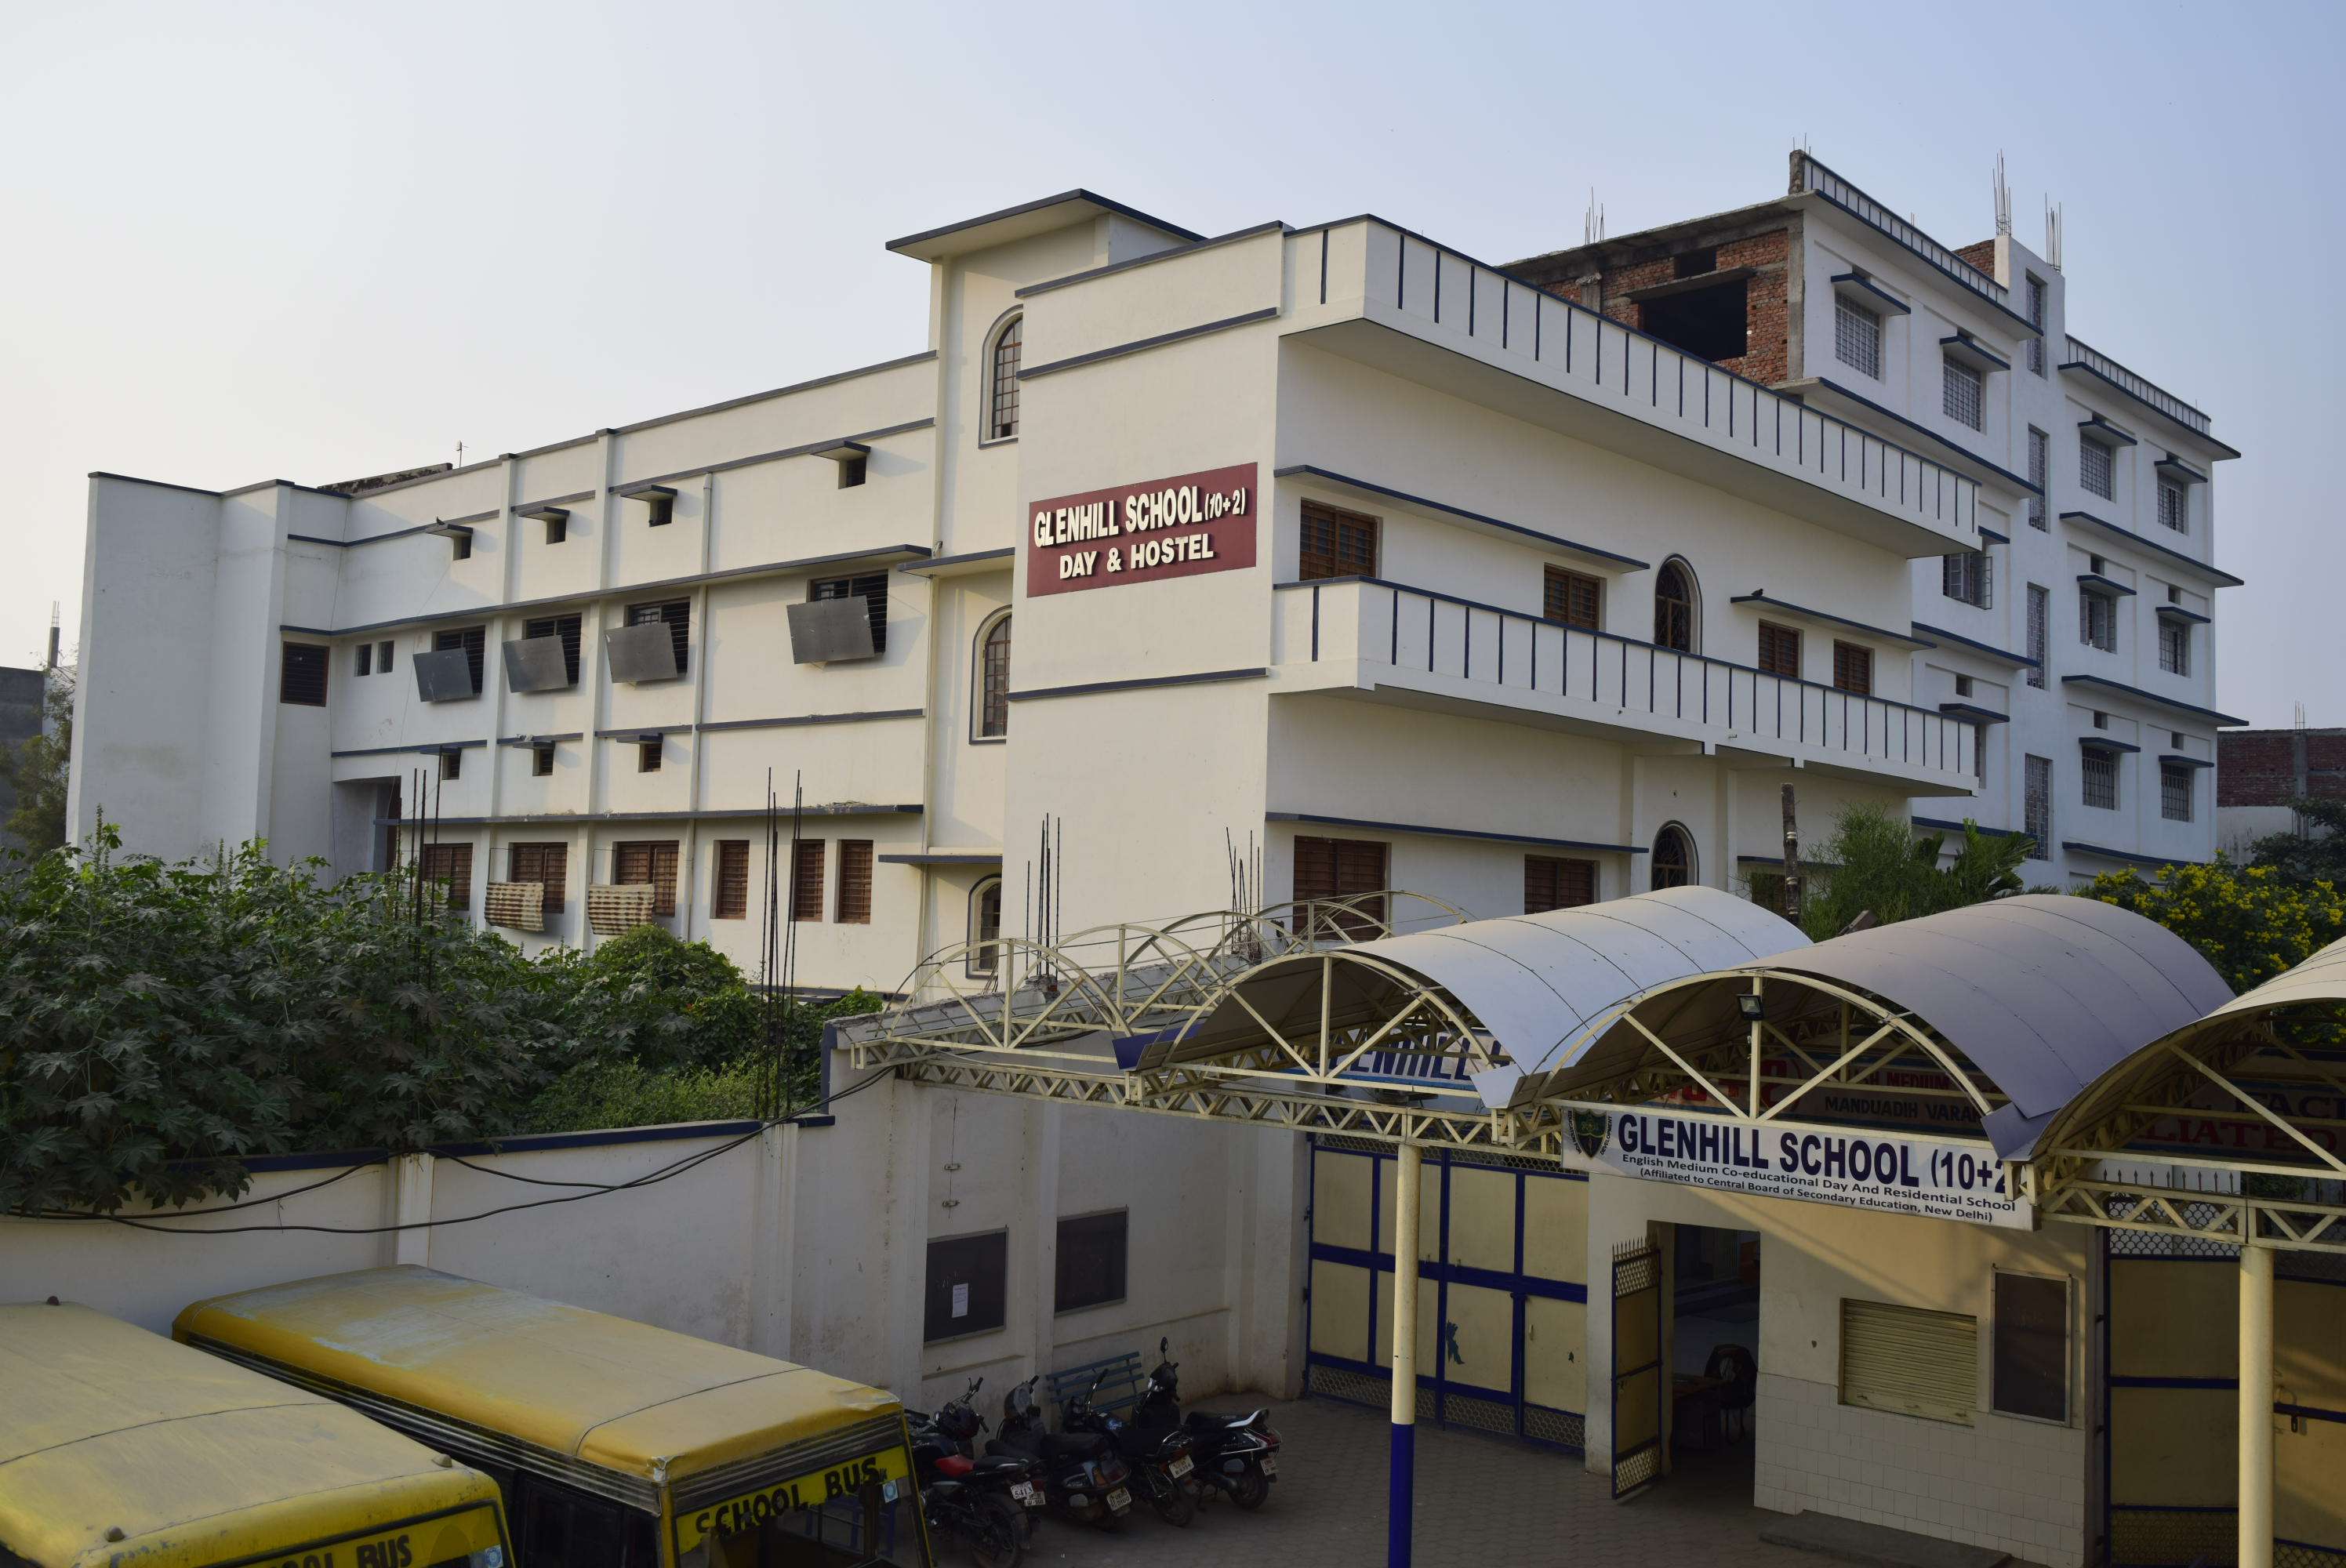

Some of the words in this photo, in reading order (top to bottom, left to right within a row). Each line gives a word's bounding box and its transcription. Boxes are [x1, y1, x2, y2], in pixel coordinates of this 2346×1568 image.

[1034, 500, 1119, 547] GLENHILL
[1125, 485, 1202, 533] SCHOOL
[1204, 487, 1246, 521] (10+2)
[1059, 550, 1097, 579] DAY
[1106, 547, 1122, 572] &
[1131, 533, 1214, 569] HOSTEL
[1825, 1096, 1918, 1119] MANDUADIH
[1618, 1114, 1769, 1169] GLENHILL
[1779, 1132, 1919, 1188] SCHOOL
[1931, 1149, 2005, 1194] (10+2
[1622, 1154, 1663, 1167] English
[1667, 1160, 1718, 1174] Medium
[1723, 1167, 1818, 1187] Co-educational
[1823, 1179, 1848, 1192] Day
[1852, 1183, 1879, 1194] And
[1884, 1187, 1962, 1205] Residential
[1966, 1196, 2015, 1211] School
[1640, 1167, 1690, 1182] (Affiliated
[1694, 1176, 1705, 1185] to
[1707, 1177, 1745, 1189] Central
[1749, 1182, 1780, 1194] Board
[1783, 1186, 1794, 1196] of
[1797, 1189, 1856, 1205] Secondary
[1860, 1196, 1921, 1214] Education,
[1925, 1205, 1952, 1216] New
[1956, 1209, 1992, 1222] Delhi)
[695, 1484, 807, 1535] SCHOOL
[825, 1457, 881, 1498] BUS
[356, 1534, 412, 1568] BUS
